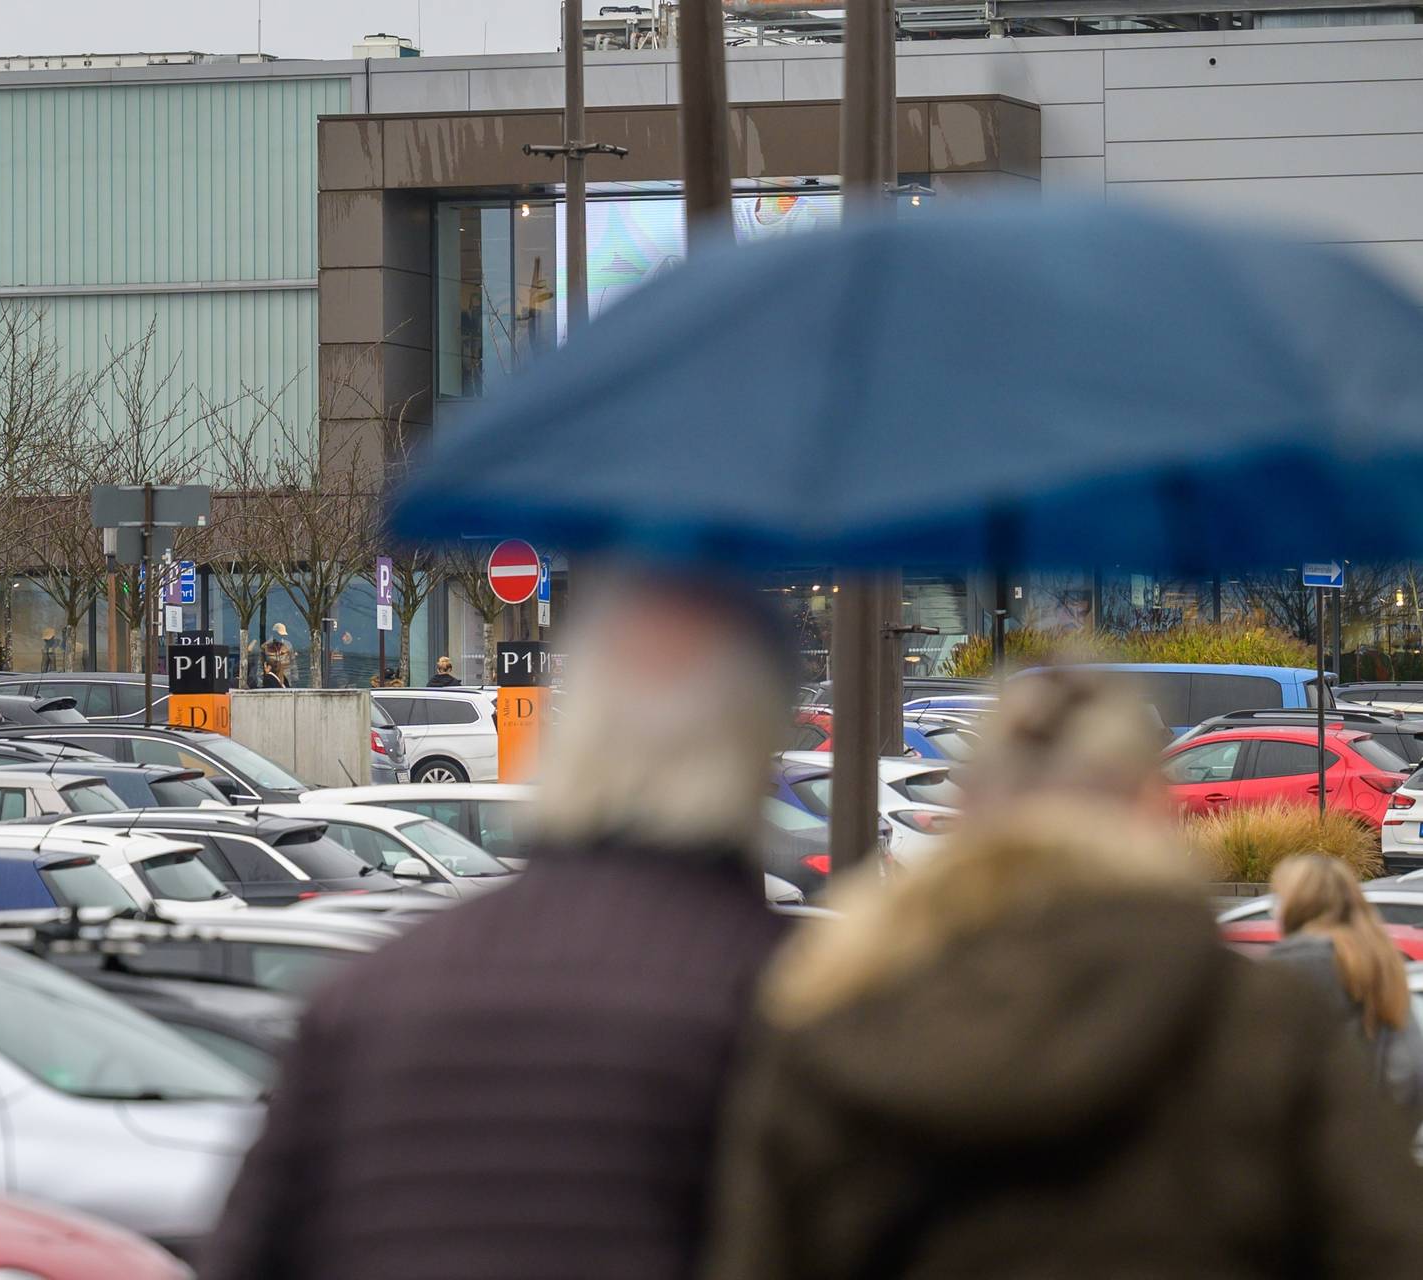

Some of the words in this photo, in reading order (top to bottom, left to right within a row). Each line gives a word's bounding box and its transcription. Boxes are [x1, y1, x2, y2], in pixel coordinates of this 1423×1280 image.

[380, 564, 390, 598] P
[173, 655, 207, 680] P1
[214, 655, 228, 680] P1
[502, 651, 533, 674] P1
[540, 651, 551, 673] P1
[189, 706, 208, 728] D
[516, 697, 533, 719] D
